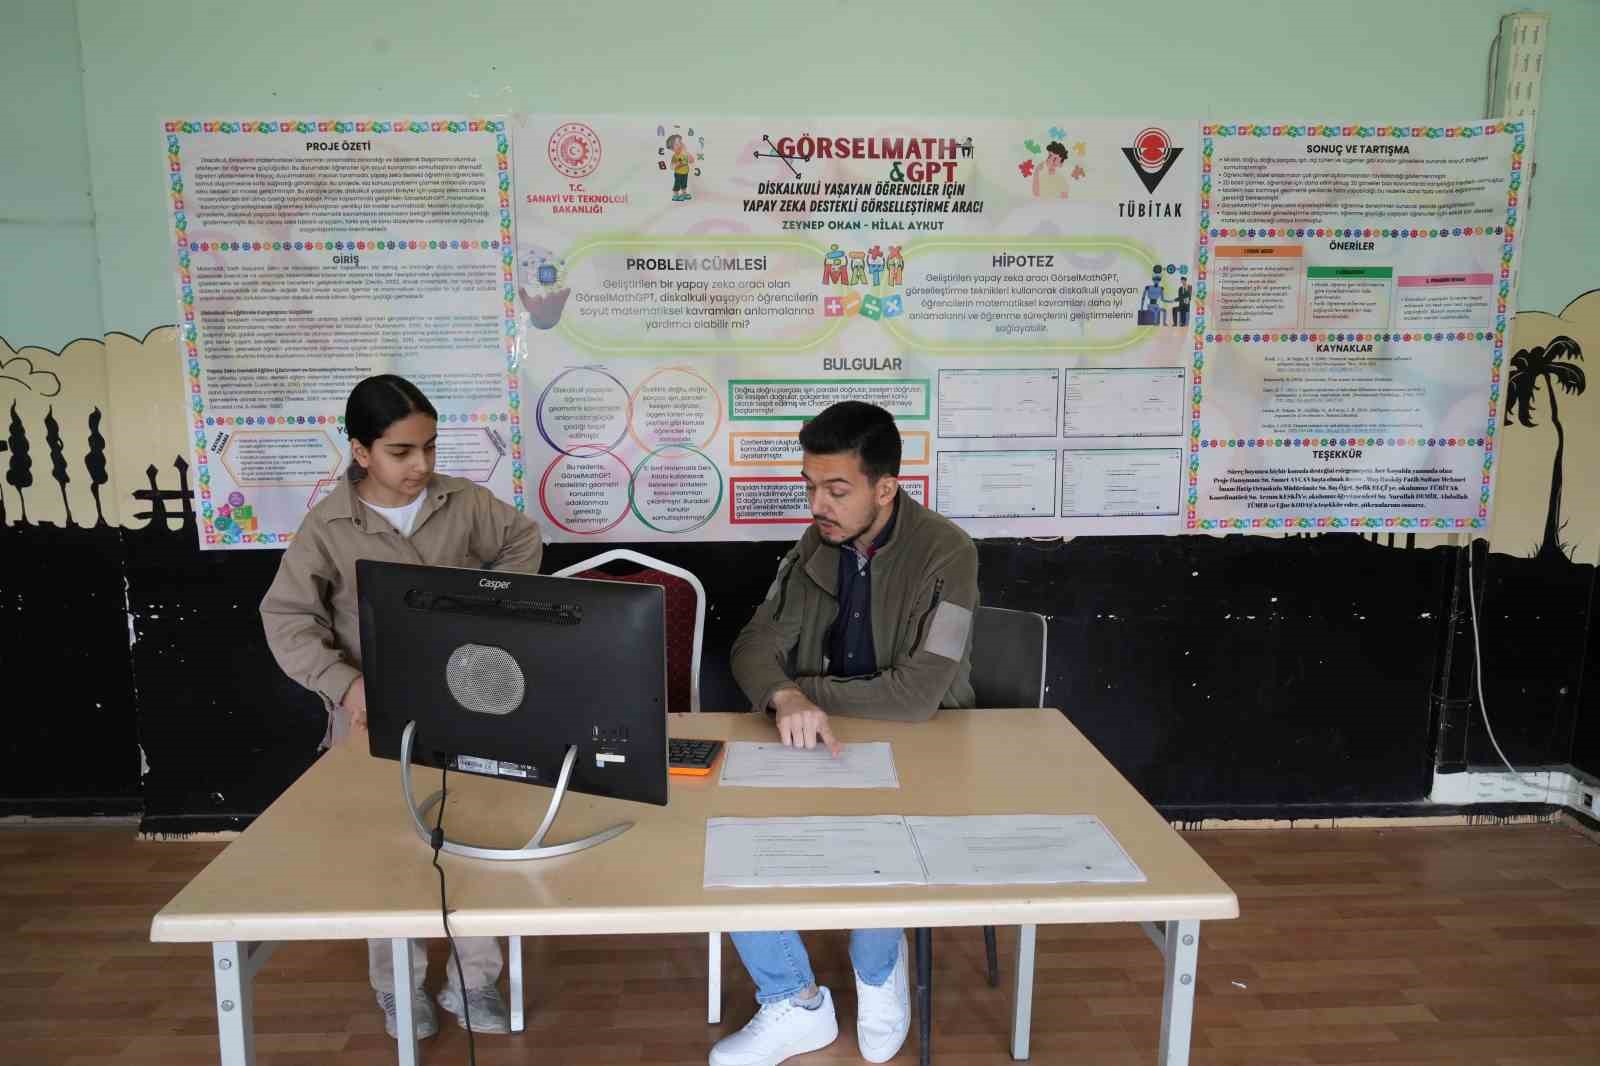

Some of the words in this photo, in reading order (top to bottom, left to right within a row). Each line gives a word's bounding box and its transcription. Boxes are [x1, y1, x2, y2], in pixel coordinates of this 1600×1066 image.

[306, 142, 339, 151] PROJE
[342, 140, 371, 151] ÖZETİ
[777, 133, 957, 159] GÖRSELMATH
[1306, 145, 1343, 156] SONUÇ
[1345, 145, 1359, 154] VE
[1359, 145, 1410, 156] TARTIŞMA
[890, 161, 958, 182] &GPT
[758, 181, 821, 195] DİSKALKULİ
[824, 183, 871, 197] YAŞAYAN
[875, 181, 939, 196] ÖĞRENCİLER
[942, 181, 965, 198] İÇİN
[527, 194, 561, 204] SANAYİ
[562, 195, 576, 204] VE
[552, 205, 603, 214] BAKANLIĞI
[742, 200, 777, 213] YAPAY
[779, 200, 807, 213] ZEKA
[810, 199, 858, 213] DESTEKLİ
[861, 199, 950, 216] GÖRSELLEŞTİRME
[951, 200, 984, 213] ARACI
[1119, 200, 1182, 217] TÜBİTAK
[782, 220, 825, 231] ZEYNEP
[872, 218, 905, 231] HİLAL
[1330, 240, 1375, 251] ÖNERİLER
[333, 254, 359, 266] GİRİŞ
[626, 258, 698, 271] PROBLEM
[702, 256, 767, 271] CÜMLESİ
[992, 252, 1054, 267] HİPOTEZ
[660, 280, 673, 289] bir
[676, 281, 709, 291] yapay
[767, 280, 791, 289] olan
[732, 319, 750, 329] mi?
[1316, 344, 1373, 353] KAYNAKLAR
[824, 358, 902, 371] BULGULAR
[1313, 449, 1362, 461] TEŞEKKÜR
[479, 578, 512, 592] Casper
